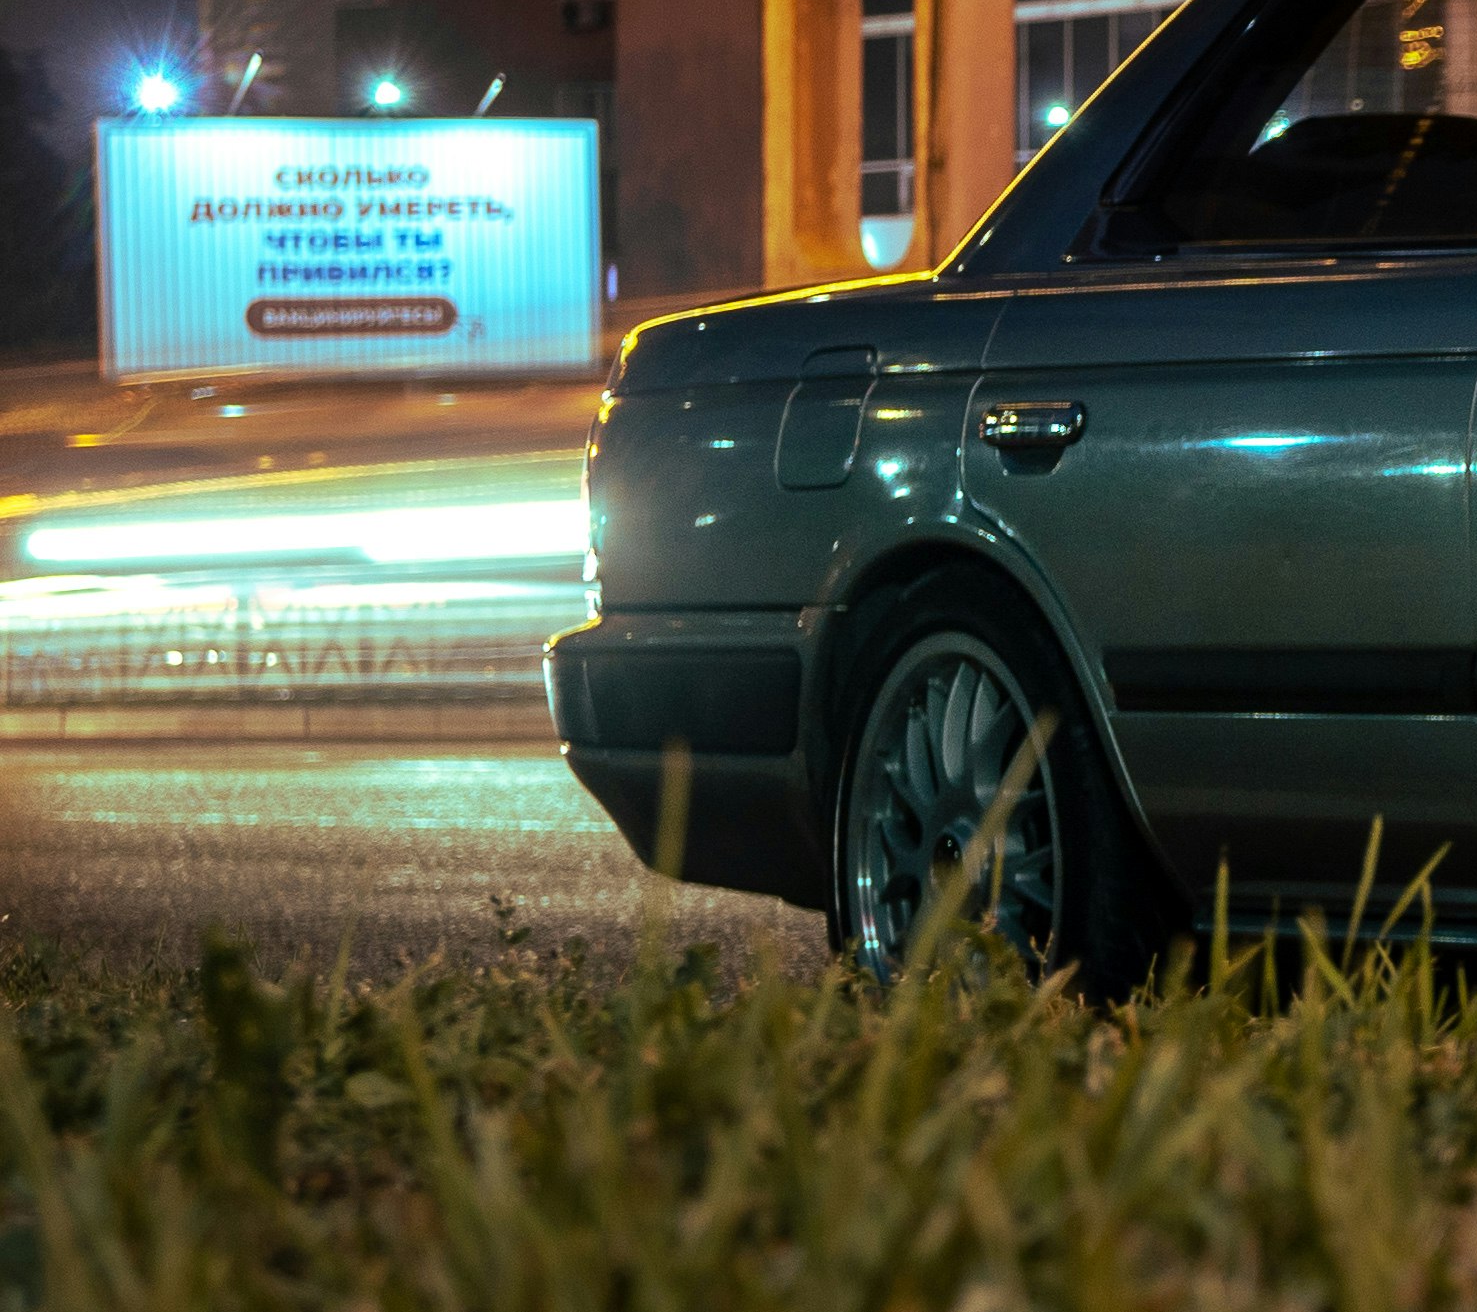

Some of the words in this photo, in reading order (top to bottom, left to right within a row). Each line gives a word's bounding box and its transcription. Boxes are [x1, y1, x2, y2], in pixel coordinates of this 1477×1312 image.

[273, 164, 430, 191] СКОЛЬКО
[189, 195, 344, 224] ДОЛЖНО
[357, 195, 514, 223] УМЕРЕТЬ,
[265, 227, 383, 253] ЧТОБЫ
[391, 227, 443, 251] ТЫ
[256, 258, 454, 286] ПРИВИЛСЯ?
